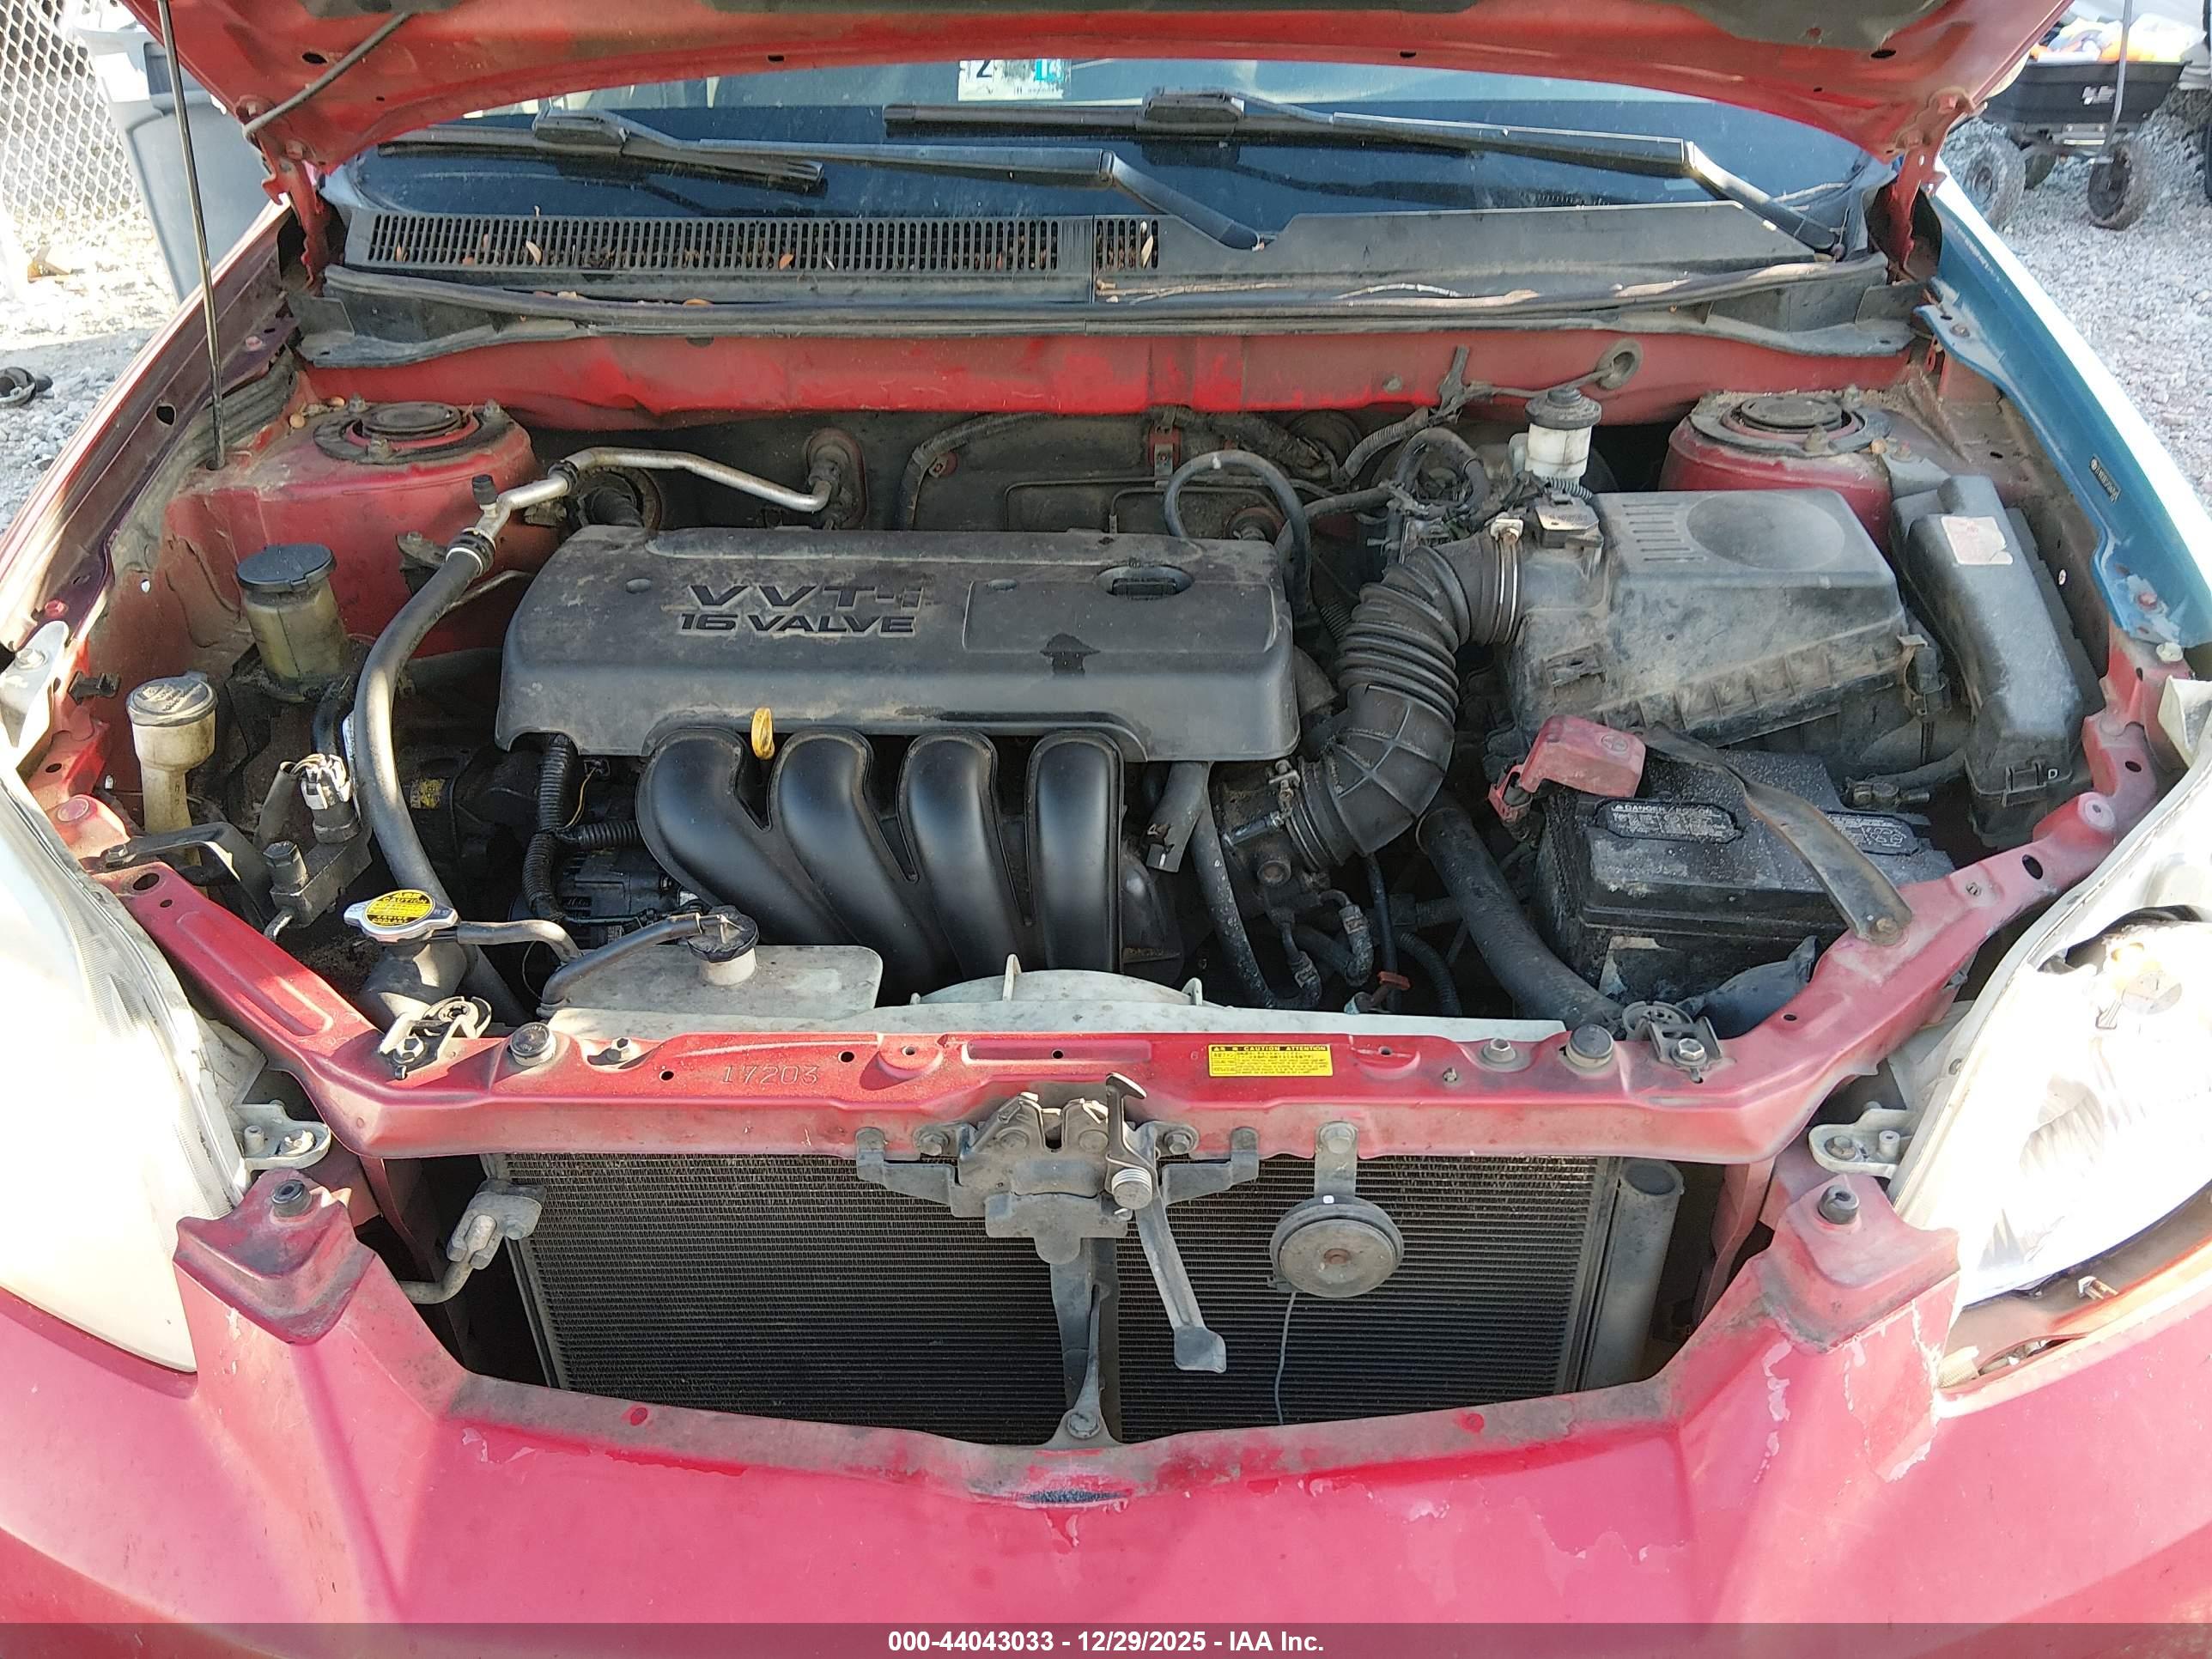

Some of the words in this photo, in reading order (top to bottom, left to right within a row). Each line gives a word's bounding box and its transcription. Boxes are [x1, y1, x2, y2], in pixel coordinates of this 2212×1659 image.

[680, 613, 738, 632] 16
[748, 613, 915, 634] VALVE
[722, 1064, 819, 1085] 17203
